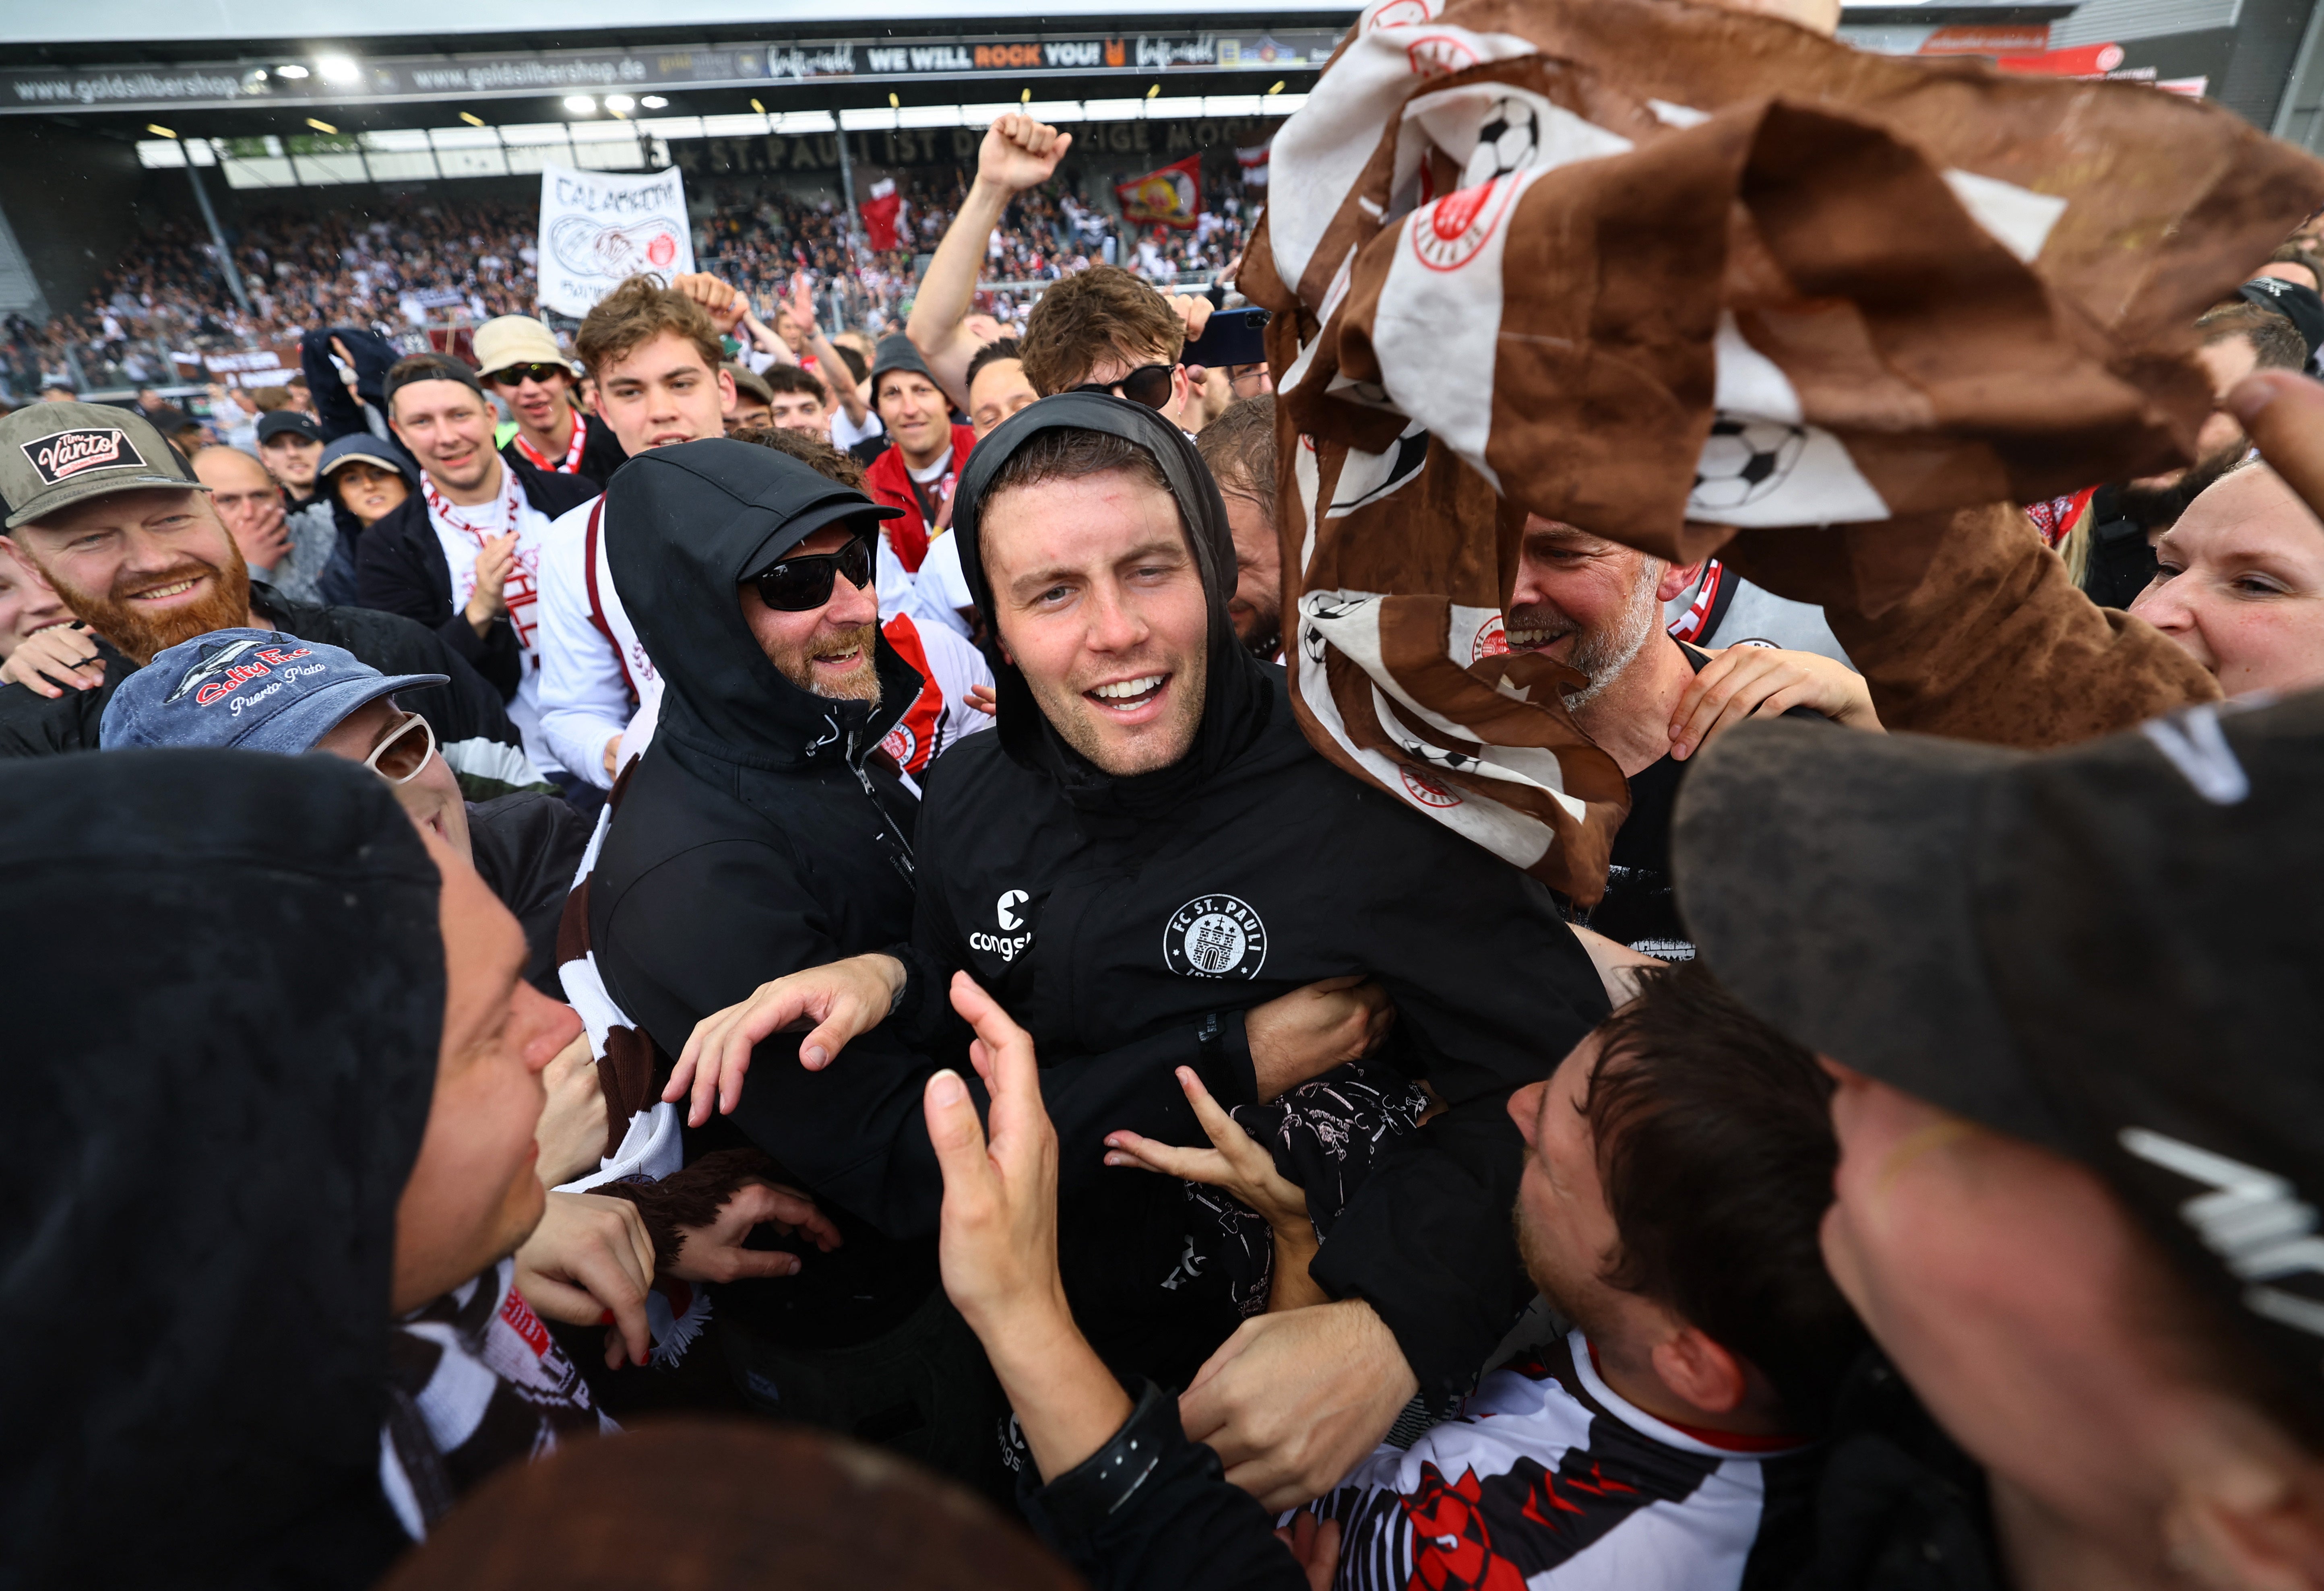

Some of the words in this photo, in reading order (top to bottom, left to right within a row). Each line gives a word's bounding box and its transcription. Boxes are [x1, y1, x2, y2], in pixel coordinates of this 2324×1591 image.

[867, 47, 908, 71] WE
[911, 45, 972, 70] WILL
[974, 43, 1041, 68] ROCK
[1044, 42, 1101, 65] YOU!
[196, 661, 271, 707] Salty
[254, 648, 312, 665] Fins
[230, 682, 282, 717] Puerto
[284, 663, 326, 683] Plata
[1172, 912, 1192, 933] FC
[1194, 899, 1219, 915] ST.
[1225, 900, 1262, 951] PAULI
